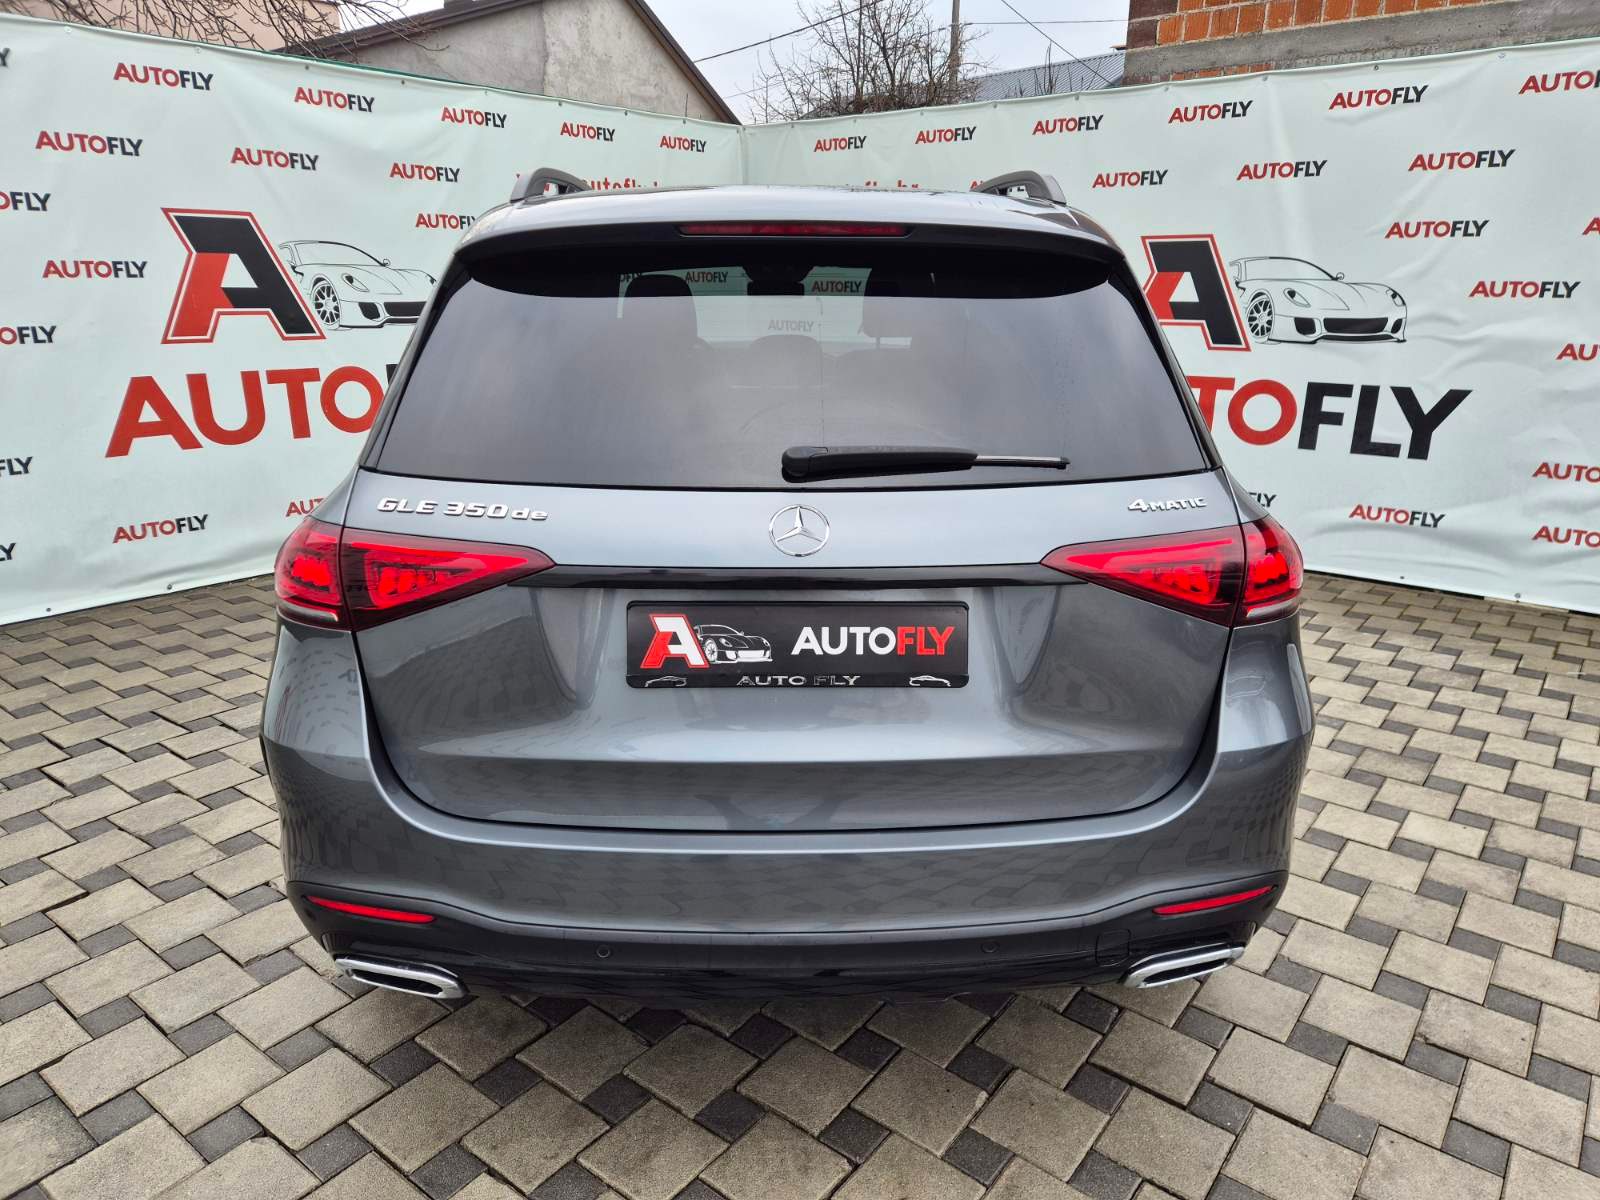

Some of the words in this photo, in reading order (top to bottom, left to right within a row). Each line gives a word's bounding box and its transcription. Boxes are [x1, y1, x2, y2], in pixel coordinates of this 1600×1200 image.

[114, 63, 213, 90] AUTOFLY
[295, 88, 374, 112] AUTOFLY
[1329, 85, 1428, 109] AUTOFLY
[442, 108, 506, 128] AUTOFLY
[1169, 100, 1252, 123] AUTOFLY
[561, 122, 615, 141] AUTOFLY
[1033, 115, 1103, 135] AUTOFLY
[36, 131, 142, 156] AUTOFLY
[660, 136, 706, 152] AUTOFLY
[814, 136, 866, 152] AUTOFLY
[915, 127, 976, 144] AUTOFLY
[232, 148, 318, 170] AUTOFLY
[1408, 149, 1515, 171] AUTOFLY
[391, 163, 460, 182] AUTOFLY
[1093, 170, 1168, 188] AUTOFLY
[1237, 160, 1327, 180] AUTOFLY
[1385, 220, 1489, 238] AUTOFLY
[43, 260, 147, 279] AUTOFLY
[811, 280, 861, 292] AUTOFLY
[1470, 281, 1580, 298] AUTOFLY
[106, 366, 398, 456] AUTO
[377, 497, 438, 514] GLE
[1350, 505, 1445, 528] AUTOFLY
[113, 514, 208, 543] AUTOFLY
[791, 626, 955, 656] AUTOFLY
[736, 675, 807, 686] AUTO
[813, 675, 861, 686] FLY
